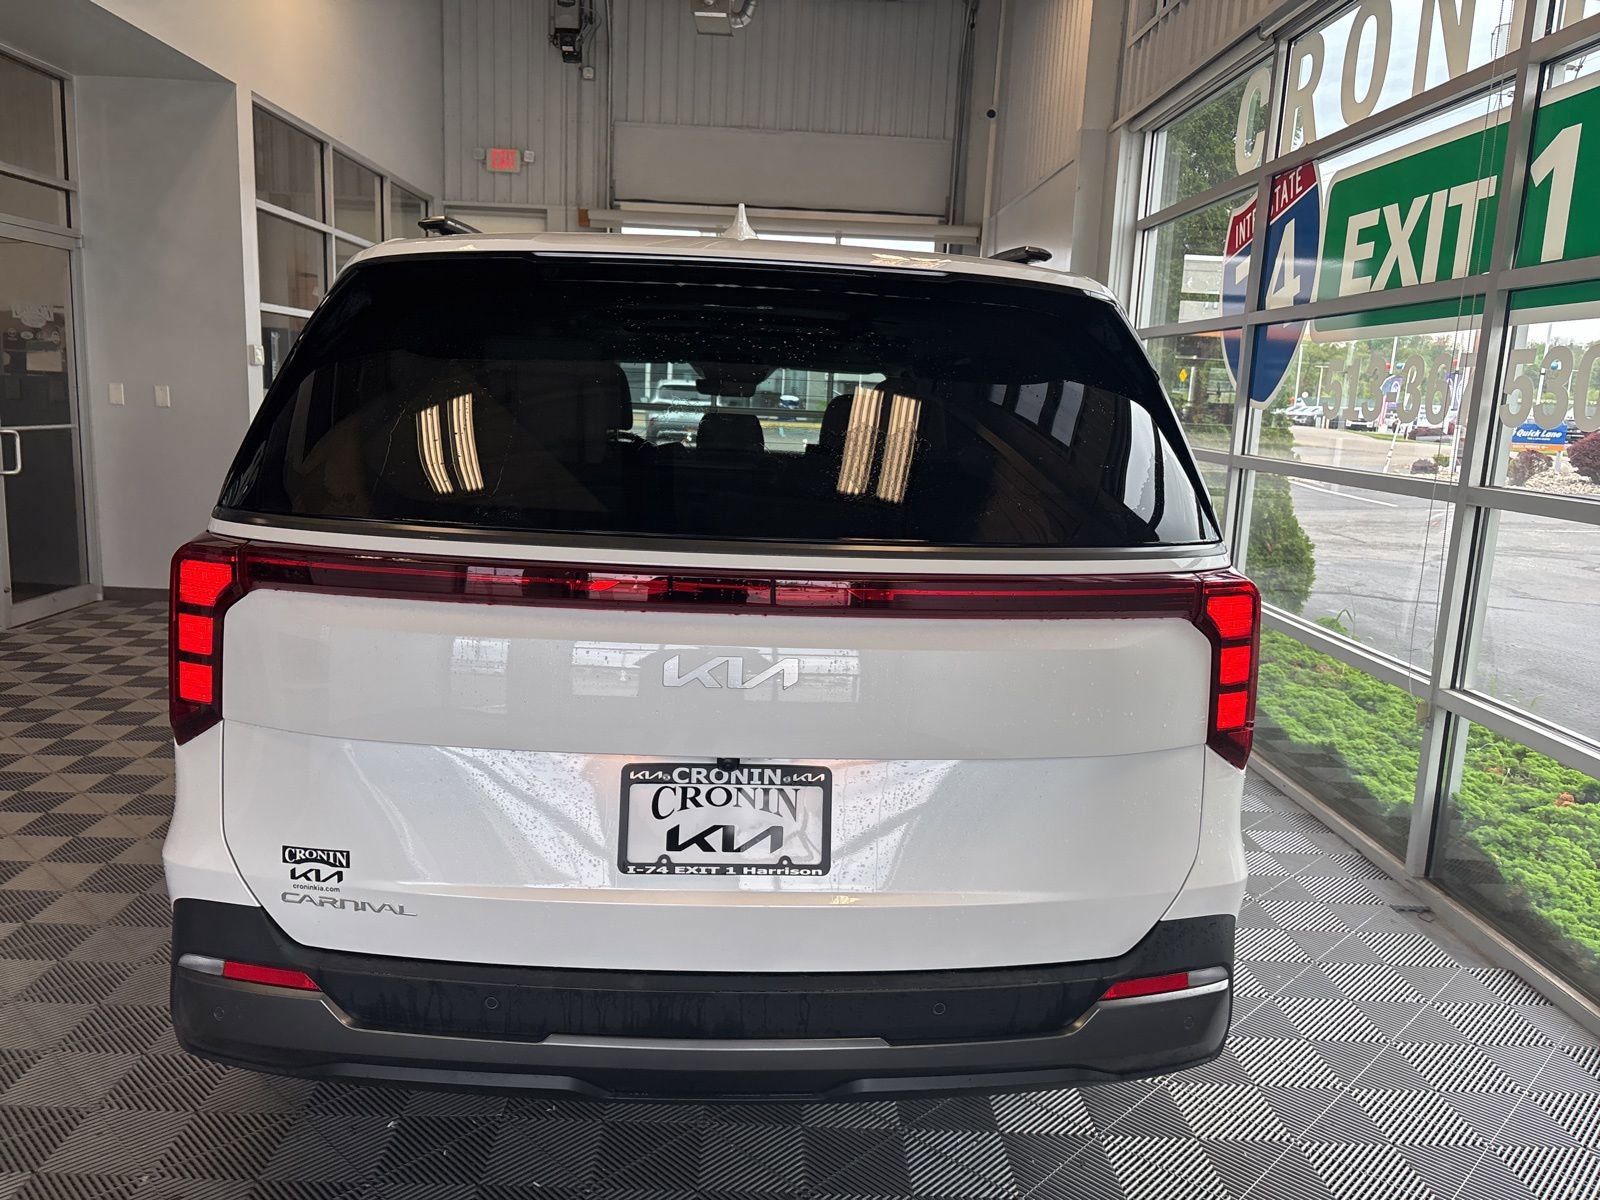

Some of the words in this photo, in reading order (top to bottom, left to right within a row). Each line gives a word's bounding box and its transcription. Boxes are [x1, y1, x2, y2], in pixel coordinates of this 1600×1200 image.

[1338, 175, 1498, 297] EXIT
[1530, 123, 1583, 263] 1
[1516, 429, 1541, 438] Quick
[1541, 429, 1563, 438] Lane
[662, 655, 799, 690] KIA
[630, 770, 662, 780] KIA
[672, 767, 782, 785] CRONIN
[792, 773, 826, 783] KIA
[651, 786, 801, 823] CRONIN
[666, 824, 784, 854] KIA
[284, 847, 348, 867] CRONIN
[290, 867, 343, 883] KIA
[627, 866, 668, 875] I-74
[674, 866, 720, 875] EXIT
[725, 866, 737, 875] 1
[743, 866, 823, 876] Harrison
[292, 883, 340, 893] croninkia.com
[281, 891, 418, 917] CARNIVAL
